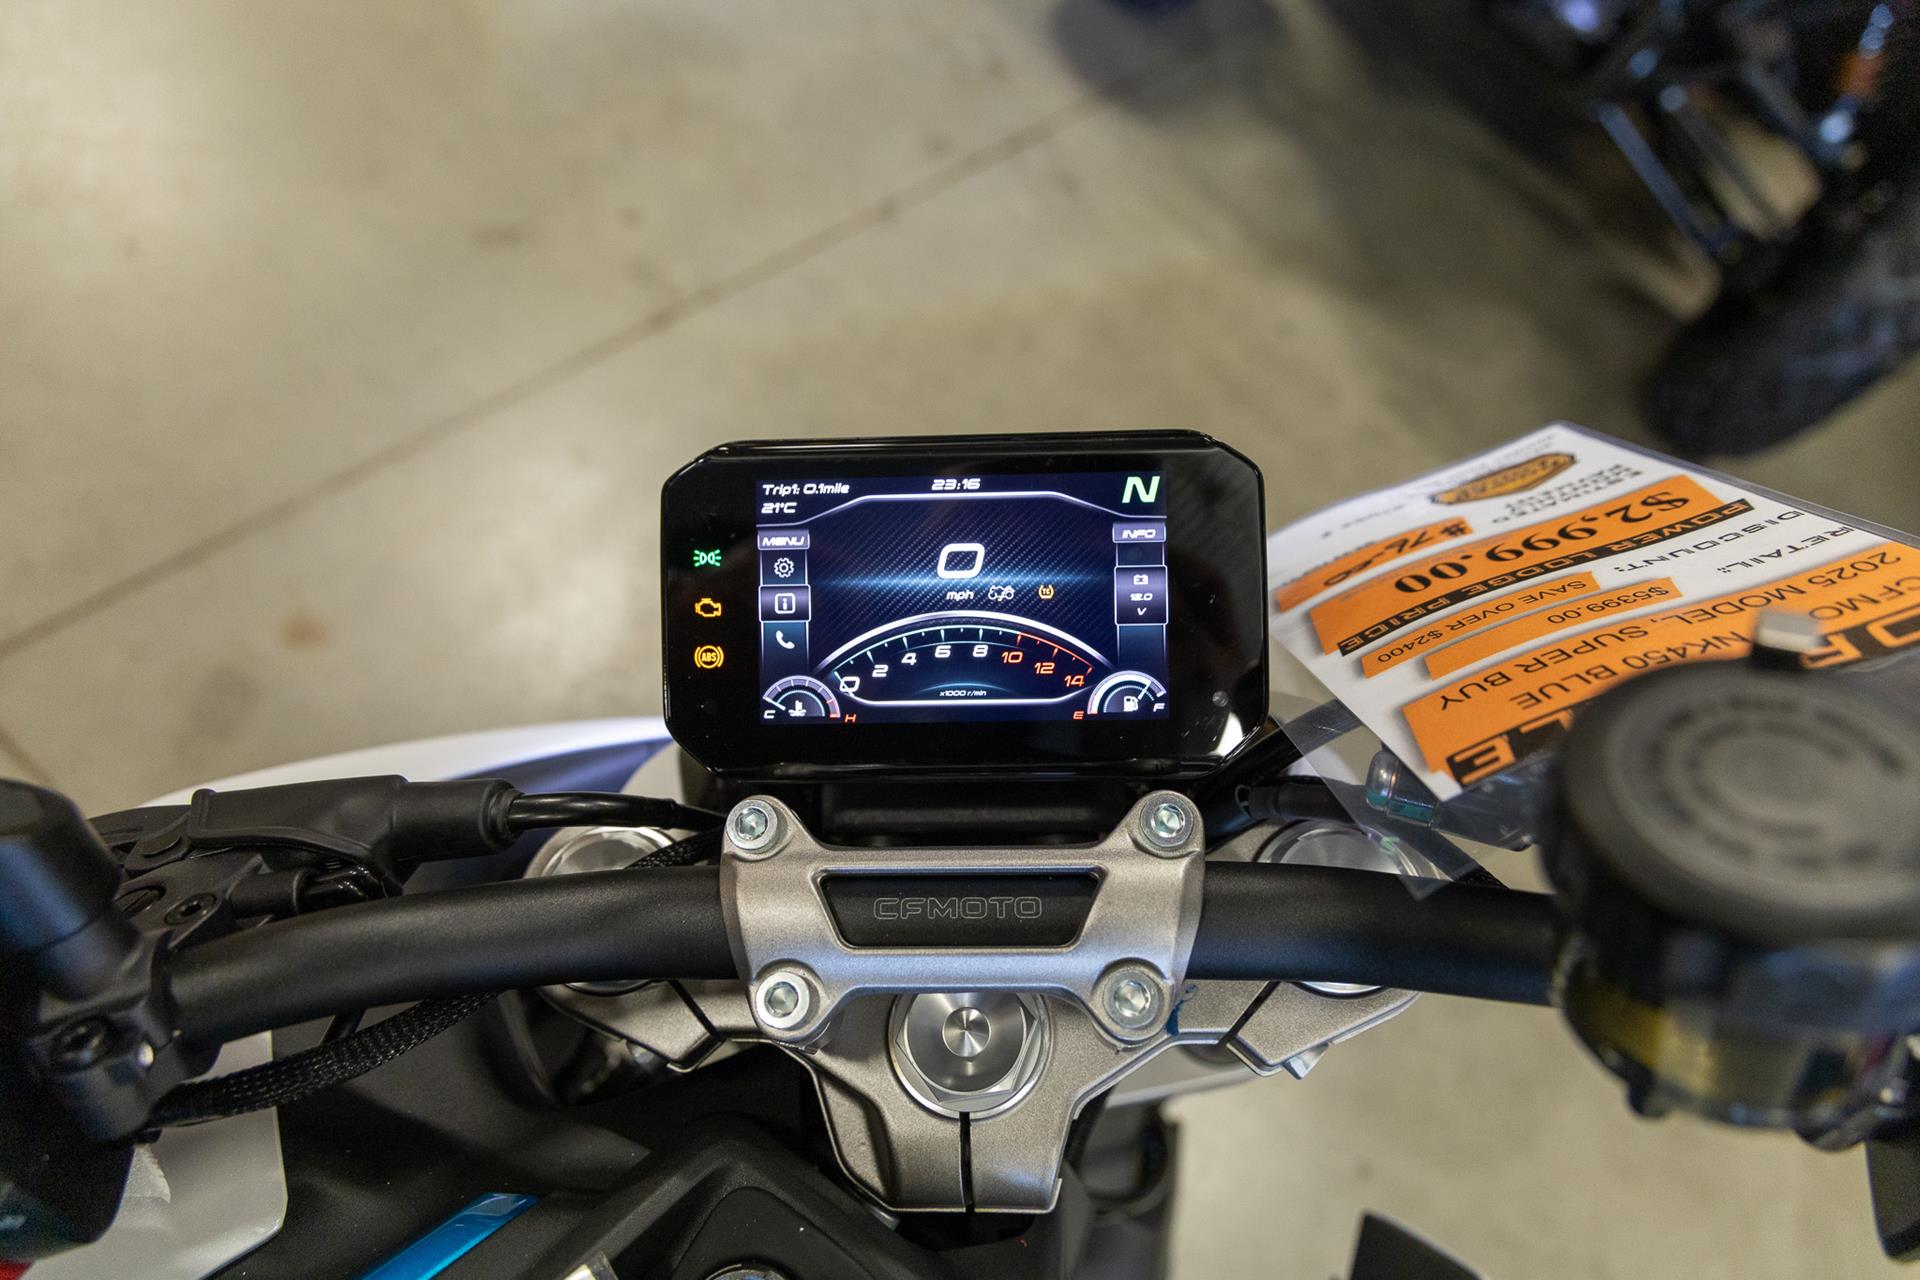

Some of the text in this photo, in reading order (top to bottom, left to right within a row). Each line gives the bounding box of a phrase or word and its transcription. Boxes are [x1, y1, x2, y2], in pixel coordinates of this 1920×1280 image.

[762, 482, 850, 497] Trip1: 0.1mile
[931, 478, 981, 491] 23:16
[1121, 476, 1160, 503] N
[761, 502, 797, 514] 21°C
[762, 536, 805, 546] MENU
[1122, 529, 1157, 539] INFO
[1394, 492, 1690, 594] $2,999.00
[1613, 510, 1805, 573] DISCOUNT:
[937, 542, 985, 579] 0
[1716, 526, 1855, 574] RETAIL:
[1338, 500, 1749, 653] POWER LODGE PRICE
[946, 590, 974, 602] mph
[1547, 586, 1670, 625] $5399.00
[1377, 580, 1586, 663] SAVE OVER $2400
[1440, 552, 1901, 711] 2025 MODEL, SUPER BUY
[1509, 576, 1920, 711] CFMO NK450 BLUE
[701, 652, 718, 662] ABS
[872, 664, 889, 677] 2
[901, 652, 917, 666] 4
[934, 645, 951, 658] 6
[972, 644, 989, 658] 8
[1001, 651, 1023, 664] 10
[1034, 662, 1056, 674] 12
[1064, 675, 1085, 688] 14
[763, 709, 776, 719] C
[844, 714, 857, 723] H
[1072, 711, 1084, 720] E
[1153, 703, 1165, 712] F
[873, 896, 1042, 920] CFMOTO
